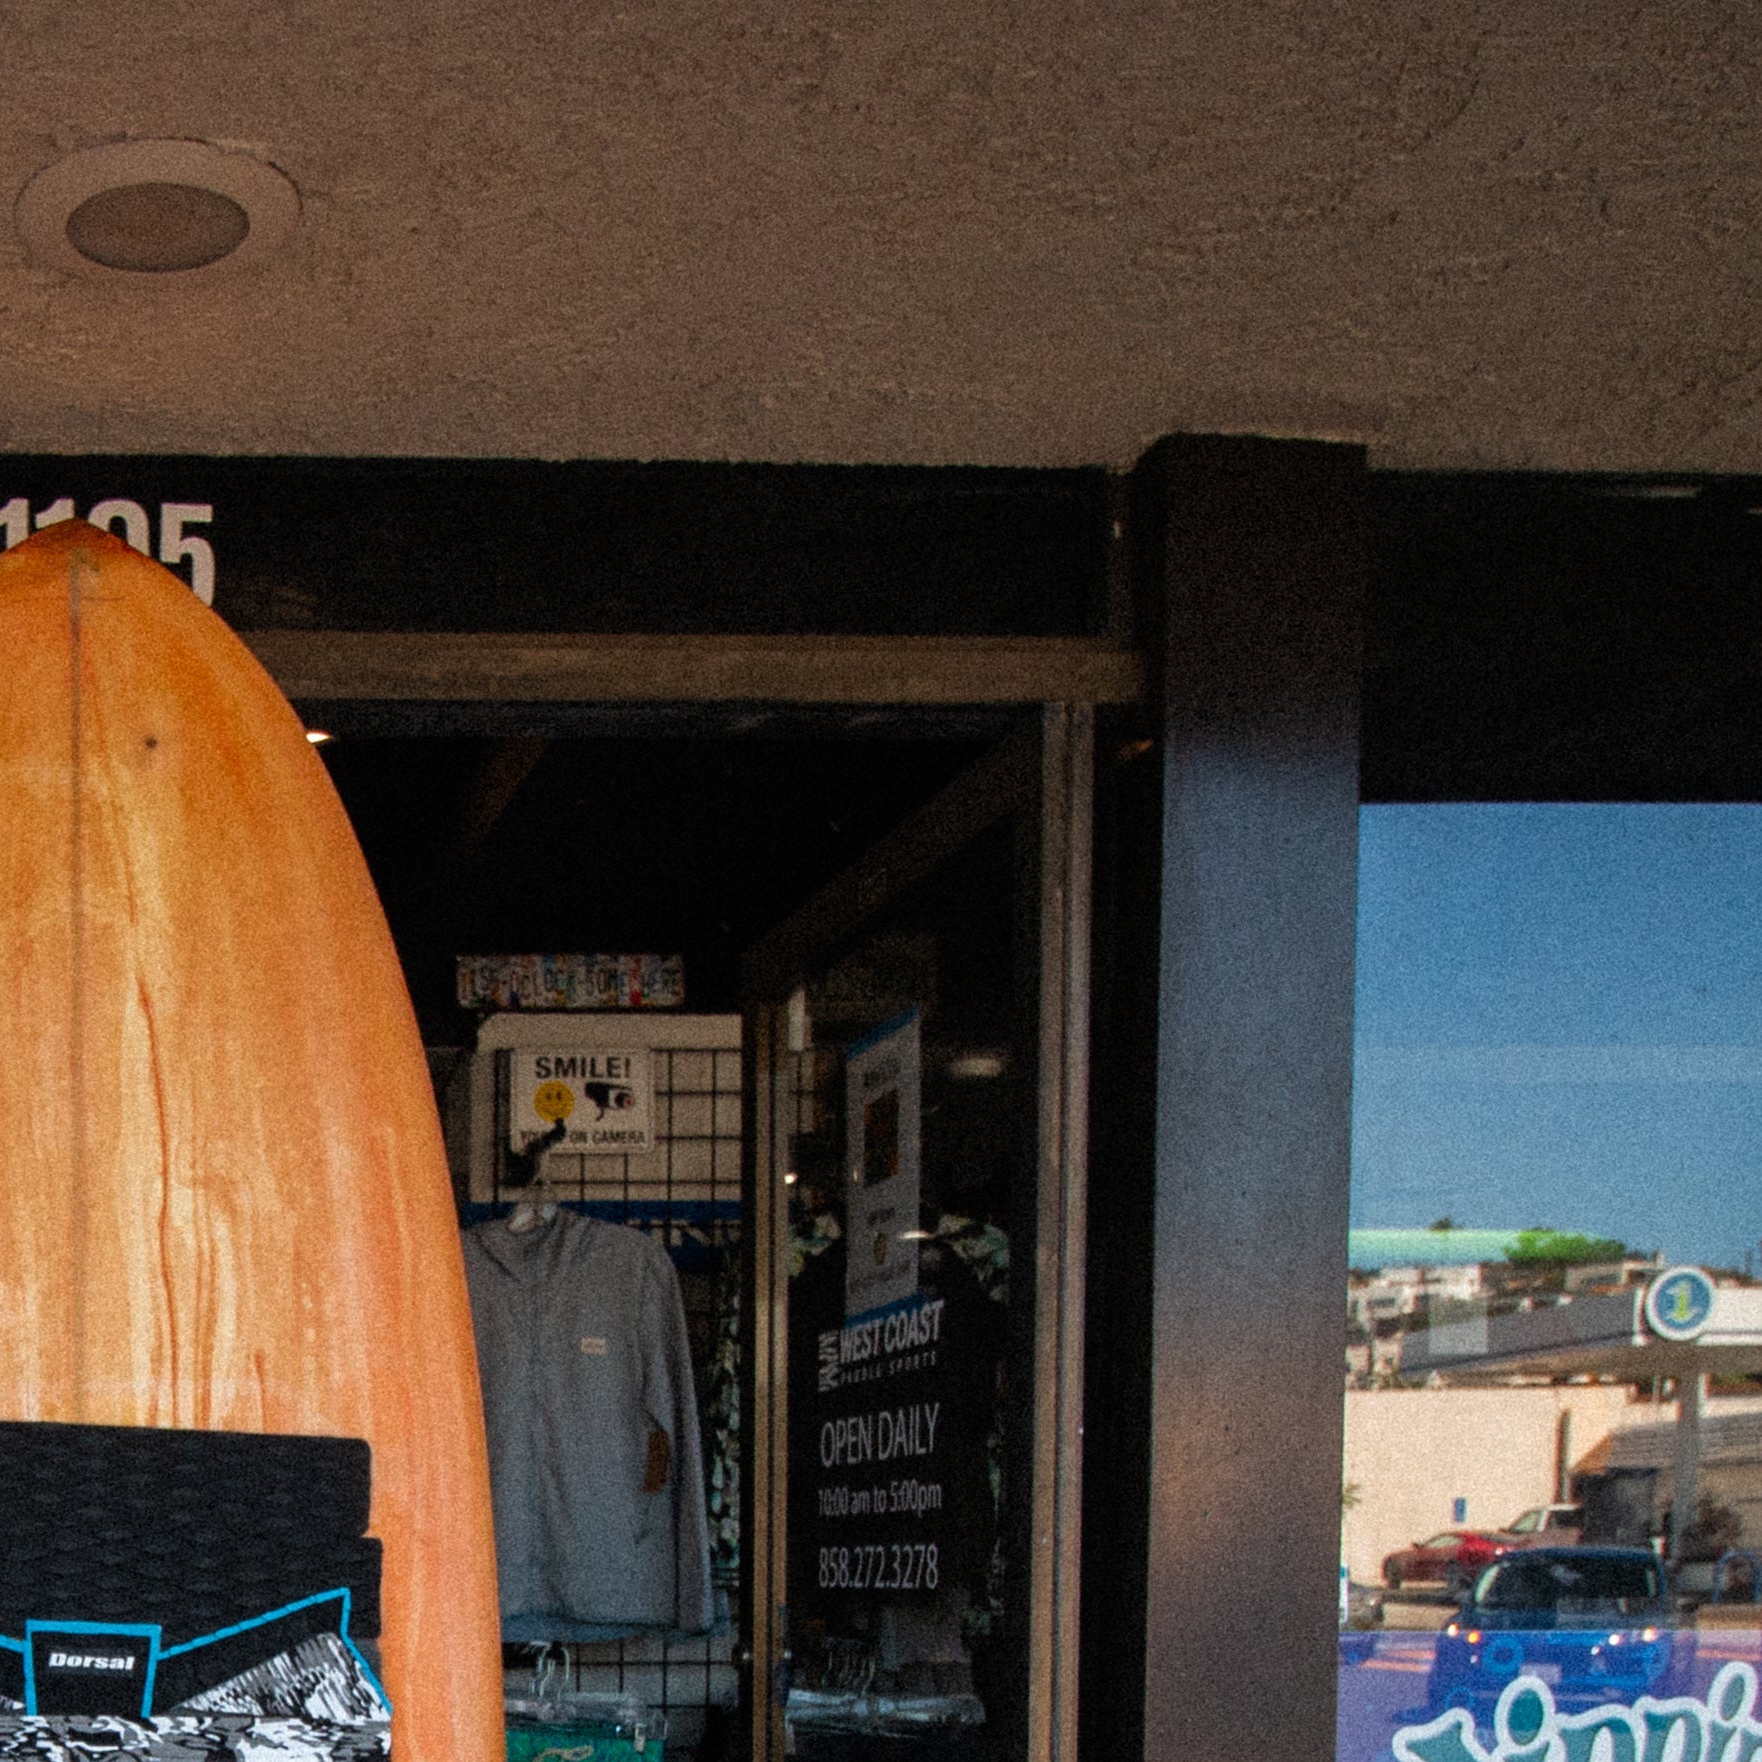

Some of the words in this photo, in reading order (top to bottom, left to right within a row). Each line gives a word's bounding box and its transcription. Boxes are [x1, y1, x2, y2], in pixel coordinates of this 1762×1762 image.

[535, 1056, 631, 1078] SMILE!
[569, 1131, 588, 1144] ON
[592, 1131, 645, 1144] CAMERA
[840, 1317, 884, 1365] WEST
[884, 1300, 945, 1353] COAST
[889, 1351, 936, 1376] SPORTS
[820, 1415, 873, 1468] OPEN
[877, 1403, 939, 1461] DAILY
[850, 1489, 871, 1515] am
[873, 1484, 887, 1514] to
[889, 1478, 943, 1518] 5:00pm
[818, 1543, 939, 1589] 858.272.3278
[48, 1652, 136, 1671] Dorsal
